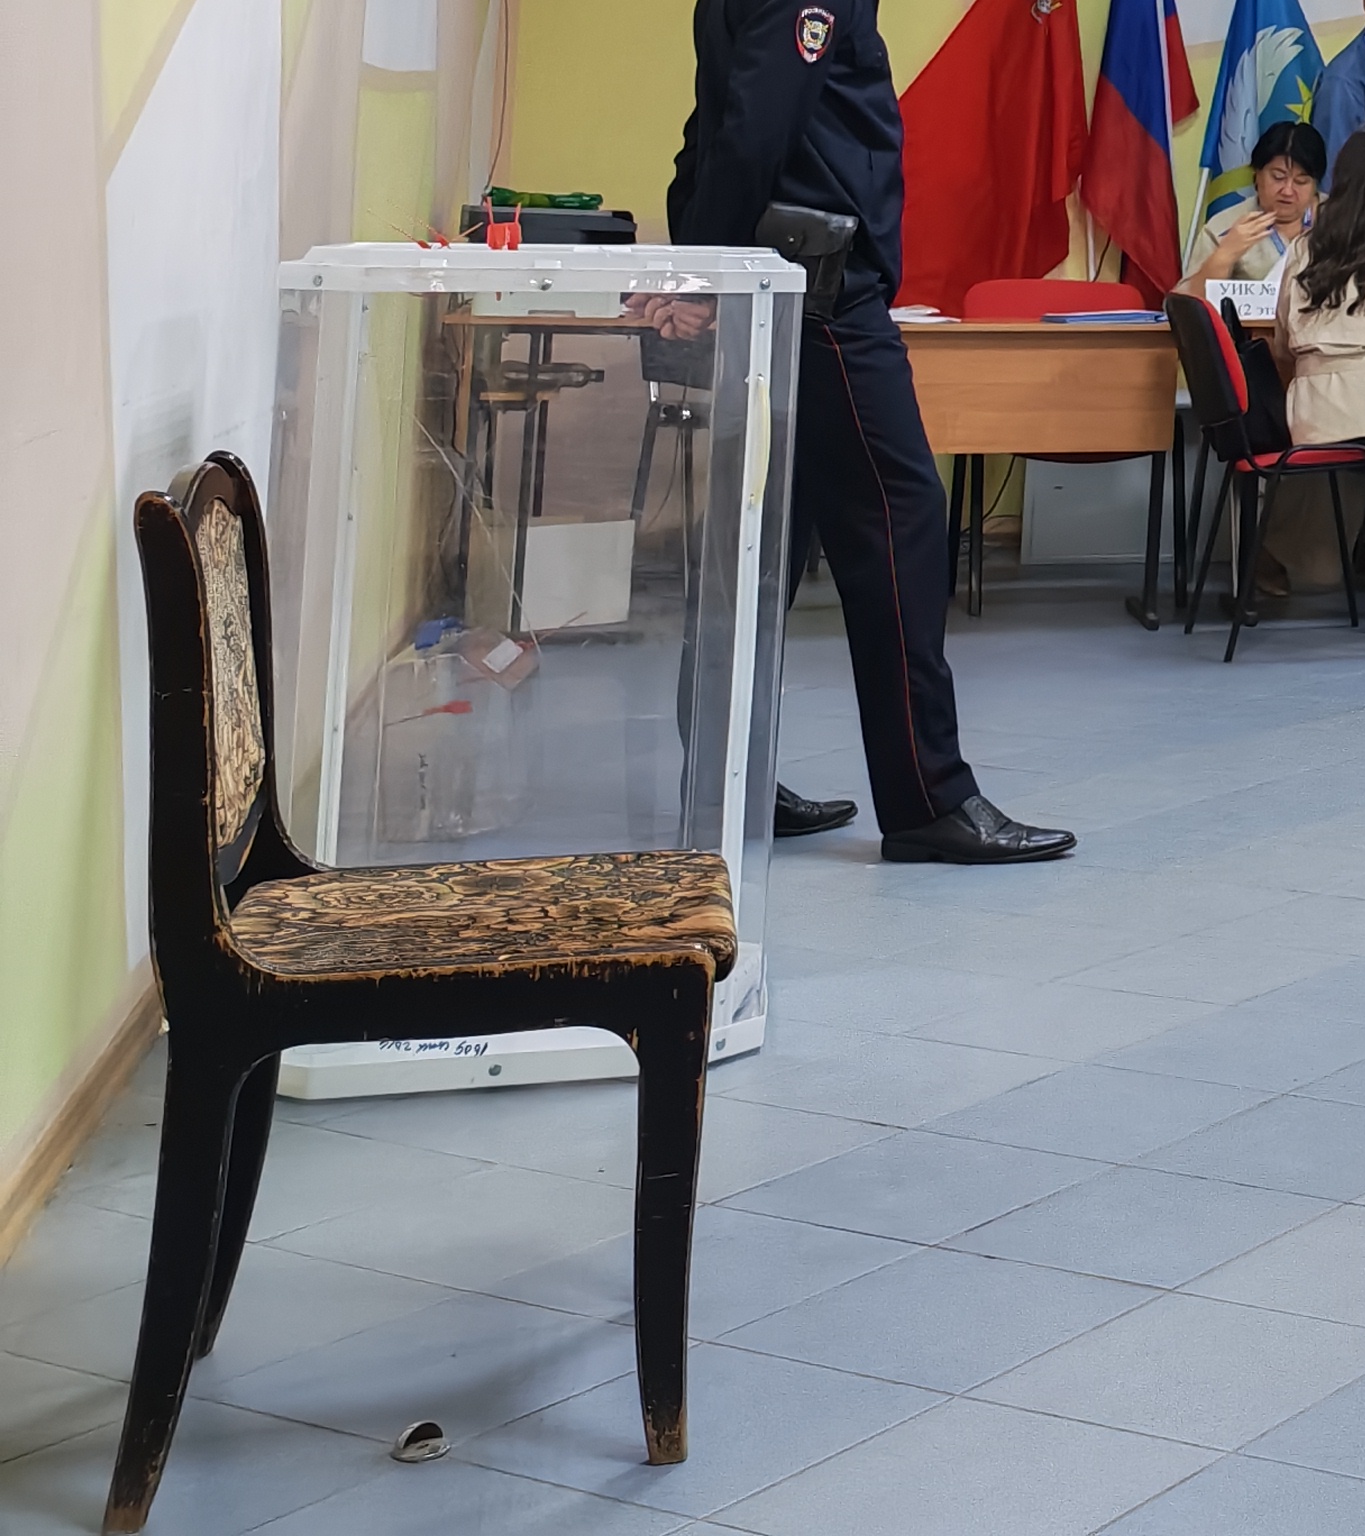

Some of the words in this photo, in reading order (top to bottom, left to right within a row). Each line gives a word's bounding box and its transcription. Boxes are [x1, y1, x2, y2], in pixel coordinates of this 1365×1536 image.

[1219, 283, 1255, 296] УИК
[1258, 283, 1277, 296] №
[1238, 303, 1252, 317] (2
